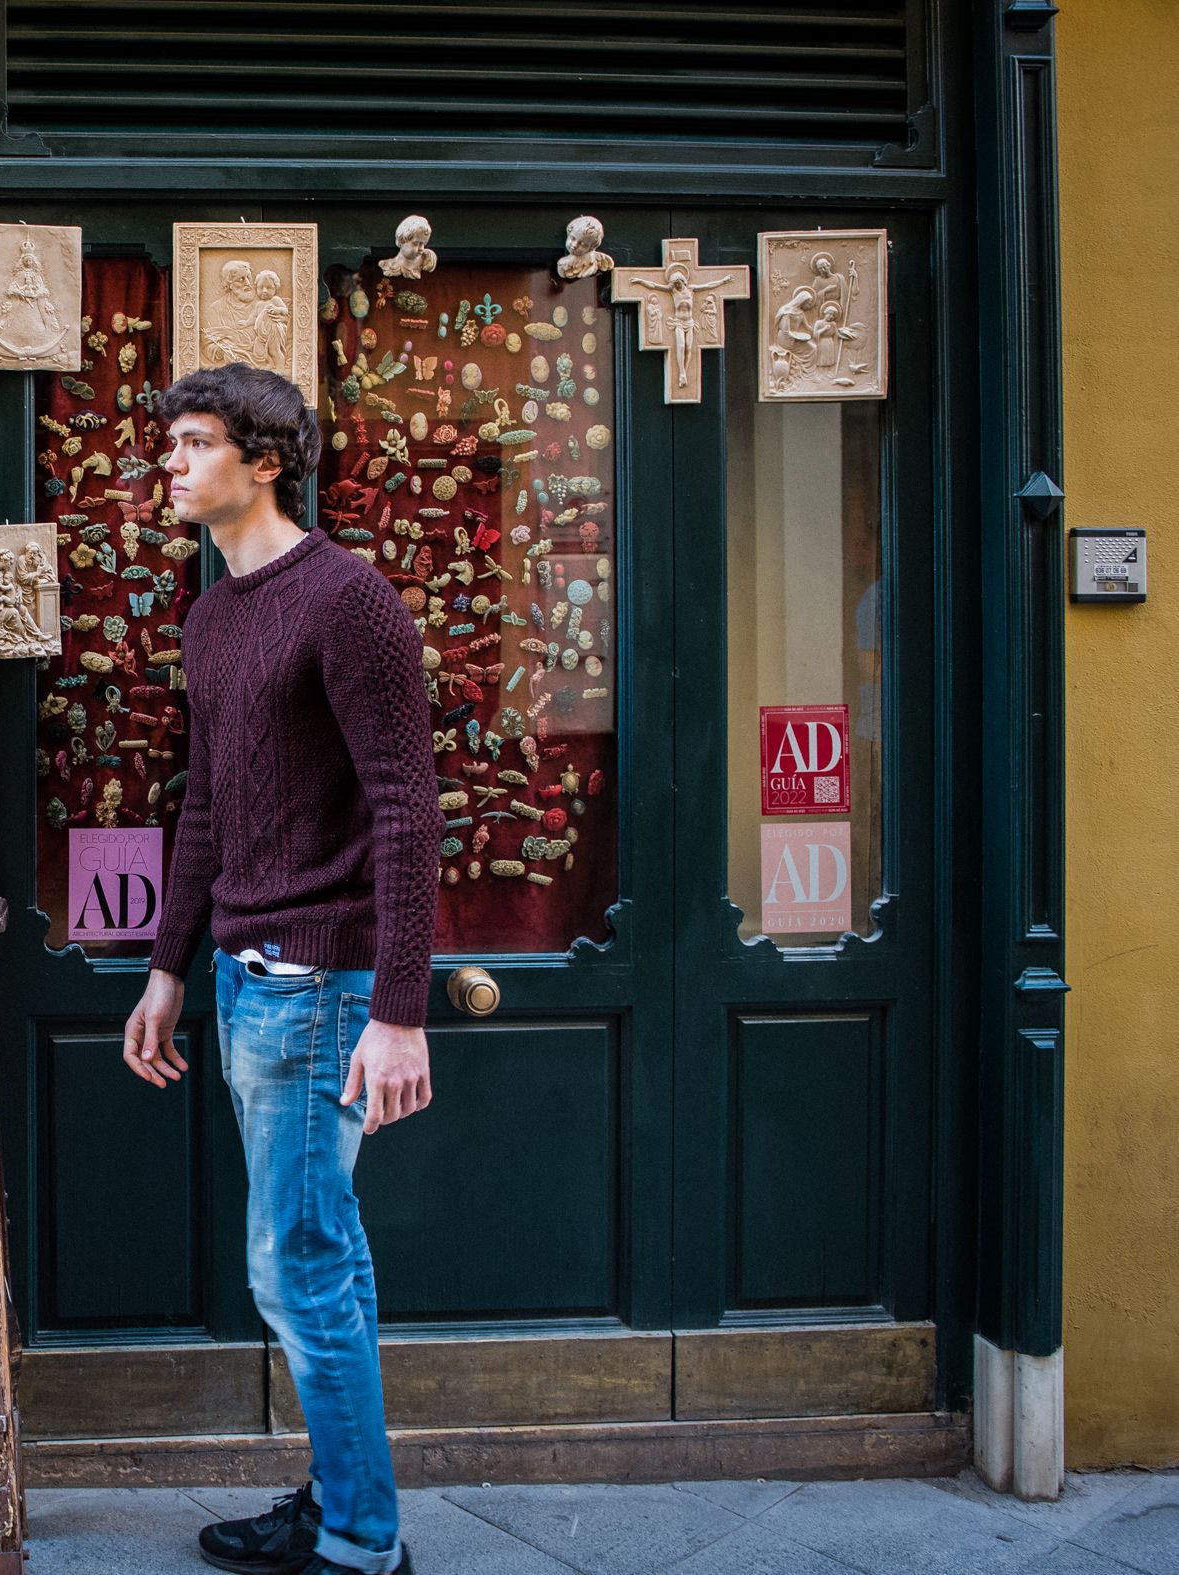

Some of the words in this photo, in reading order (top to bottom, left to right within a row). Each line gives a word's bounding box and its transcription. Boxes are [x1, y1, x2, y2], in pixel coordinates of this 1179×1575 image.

[770, 720, 842, 773] AD
[770, 774, 806, 790] GUÍA
[771, 791, 807, 805] 2022
[80, 833, 126, 844] ELEGIDO
[128, 833, 150, 844] POR
[79, 841, 149, 872] GUÍA
[764, 843, 848, 904] AD
[73, 872, 157, 929] AD
[130, 897, 146, 905] 2019
